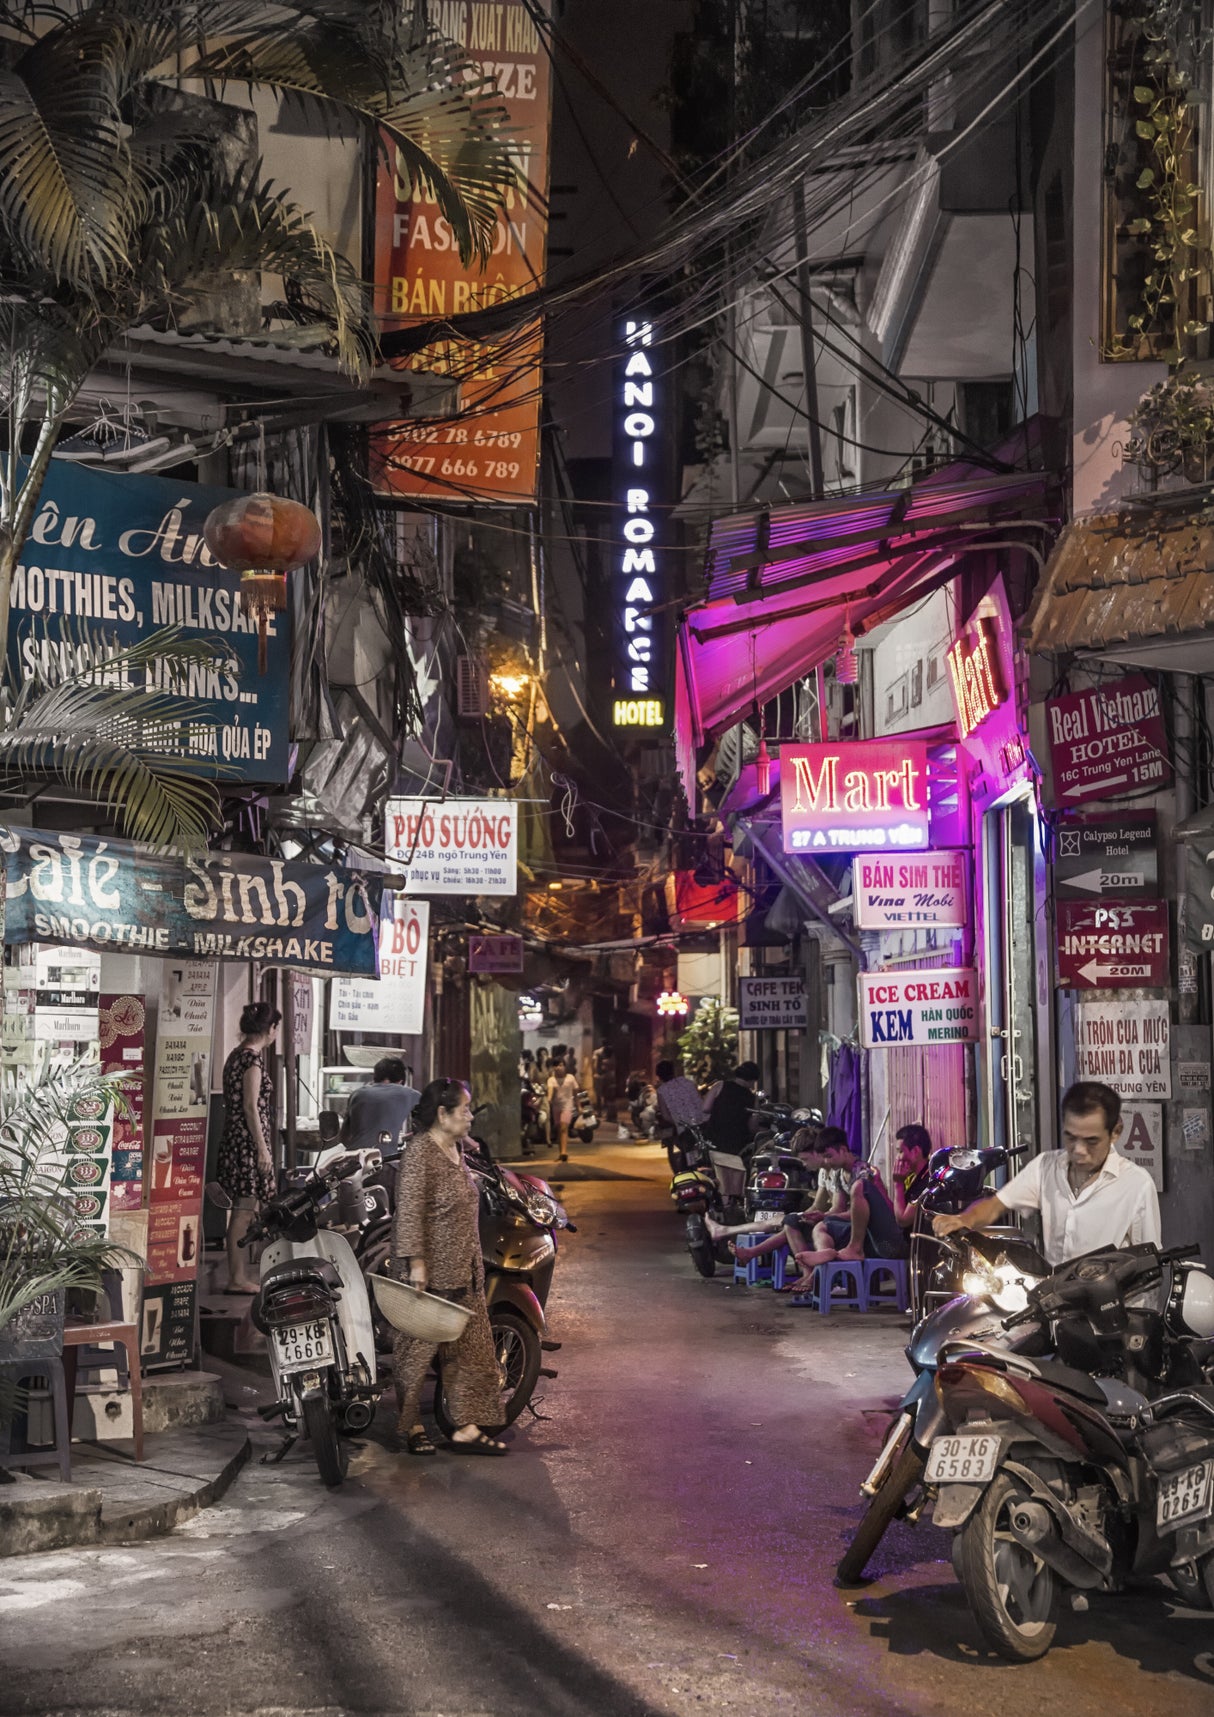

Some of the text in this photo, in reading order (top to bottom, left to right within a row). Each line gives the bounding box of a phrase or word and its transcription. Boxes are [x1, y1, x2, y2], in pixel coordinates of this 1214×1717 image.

[392, 267, 445, 315] BÁN
[624, 321, 656, 466] HANOI
[444, 428, 468, 444] 78
[474, 430, 522, 448] 6789
[441, 458, 478, 475] 666
[484, 461, 520, 478] 789
[622, 488, 656, 692] ROMANCE
[614, 700, 664, 725] HOTEL
[1050, 687, 1161, 745] Real Vietnam
[254, 721, 272, 760] ÉP
[1070, 729, 1147, 764] HOTEL
[1060, 748, 1161, 782] 16C Trung Yen Lane
[1132, 760, 1163, 782] 15M
[789, 756, 921, 813] Mart
[1083, 827, 1152, 842] Calypso Legend
[416, 850, 435, 859] 24B
[460, 851, 488, 861] Trung
[490, 850, 507, 860] Yên
[1106, 845, 1129, 856] Hotel
[862, 861, 894, 889] BÁN
[899, 865, 928, 889] SIM
[1100, 875, 1138, 886] 20m
[868, 893, 954, 907] Vina Mobi
[884, 911, 940, 921] VIETTEL
[36, 913, 170, 949] SMOOTHIE
[193, 931, 334, 964] MILKSHAKE
[391, 908, 421, 954] BÒ
[1064, 933, 1164, 955] INTERNET
[1109, 966, 1145, 976] 20M
[746, 982, 778, 996] CAFE
[868, 980, 970, 1005] ICE CREAM
[749, 1000, 780, 1011] SINH
[945, 1003, 974, 1022] QUỐC
[870, 1009, 914, 1043] KEM
[928, 1026, 969, 1040] MERINO
[1086, 1016, 1114, 1048] TRỘN
[1116, 1019, 1138, 1044] CUA
[1143, 1016, 1168, 1046] MỰC
[1119, 1050, 1134, 1075] ĐA
[1138, 1049, 1161, 1075] CUA
[1146, 1081, 1167, 1093] YÊN
[940, 1439, 989, 1457] 30-K6
[936, 1460, 985, 1477] 6583
